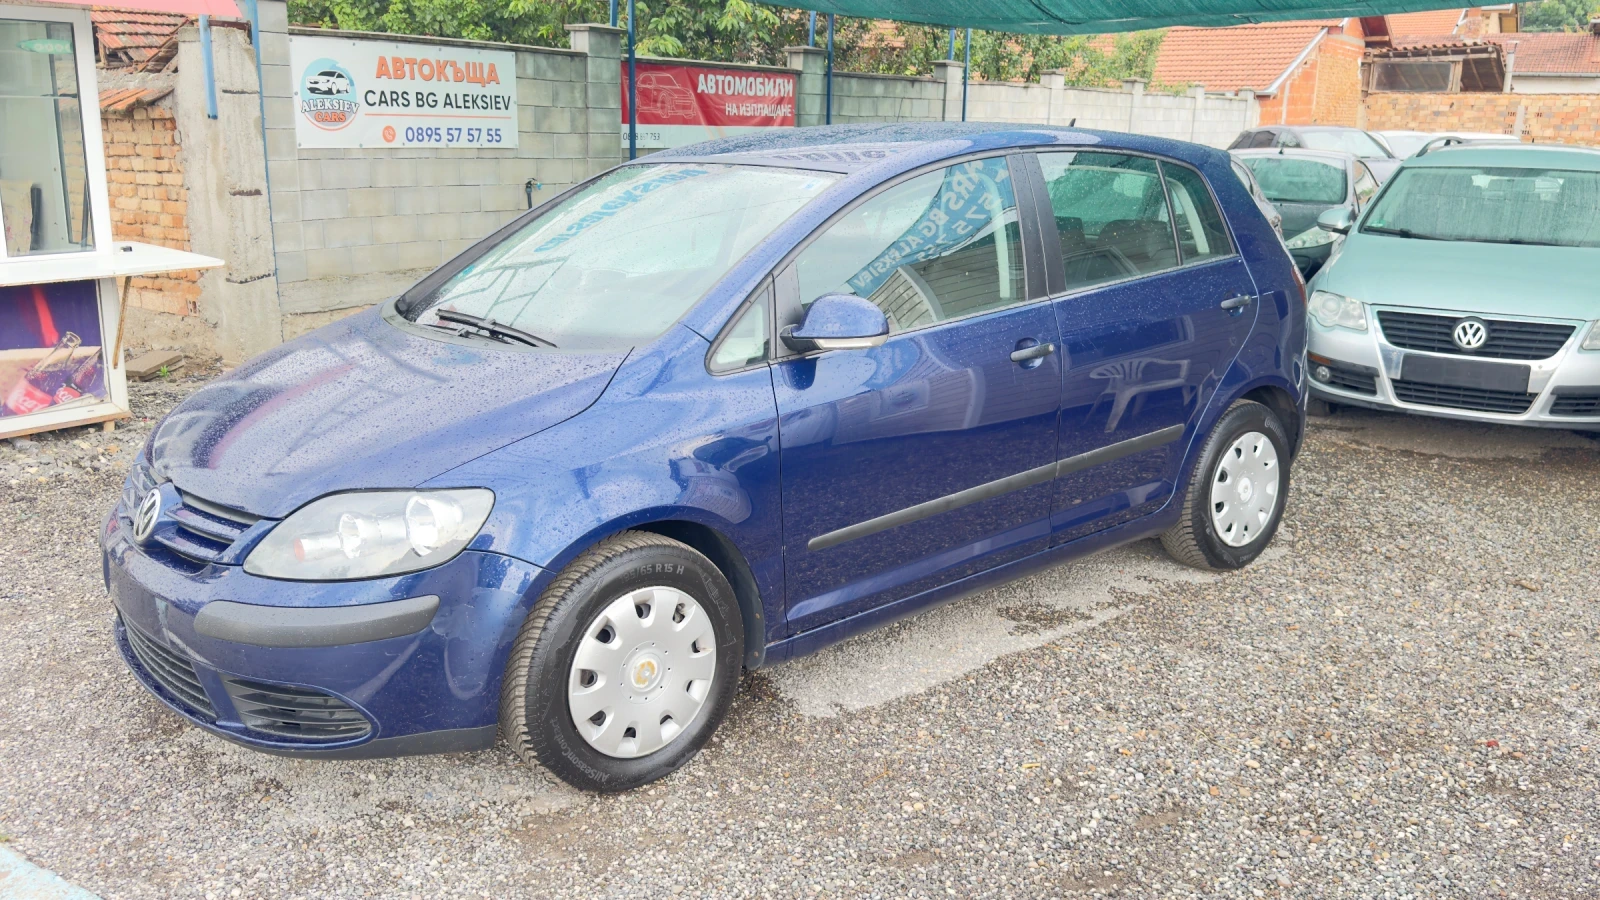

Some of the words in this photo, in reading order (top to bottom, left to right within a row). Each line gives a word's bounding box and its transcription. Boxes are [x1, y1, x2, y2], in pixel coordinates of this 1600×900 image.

[376, 56, 501, 87] АВТОКЪЩА
[697, 73, 793, 97] АВТОМОБИЛИ
[301, 97, 360, 114] ALEKSIEV
[364, 90, 410, 107] CARS
[415, 92, 438, 108] BG
[443, 93, 511, 110] ALEKSIEV
[315, 111, 347, 123] CARS
[725, 103, 738, 116] НА
[740, 103, 792, 119] ИЗПЛАЩАНЕ
[405, 126, 442, 143] 0895
[446, 127, 462, 143] 57
[467, 128, 482, 143] 57
[486, 128, 502, 143] 55
